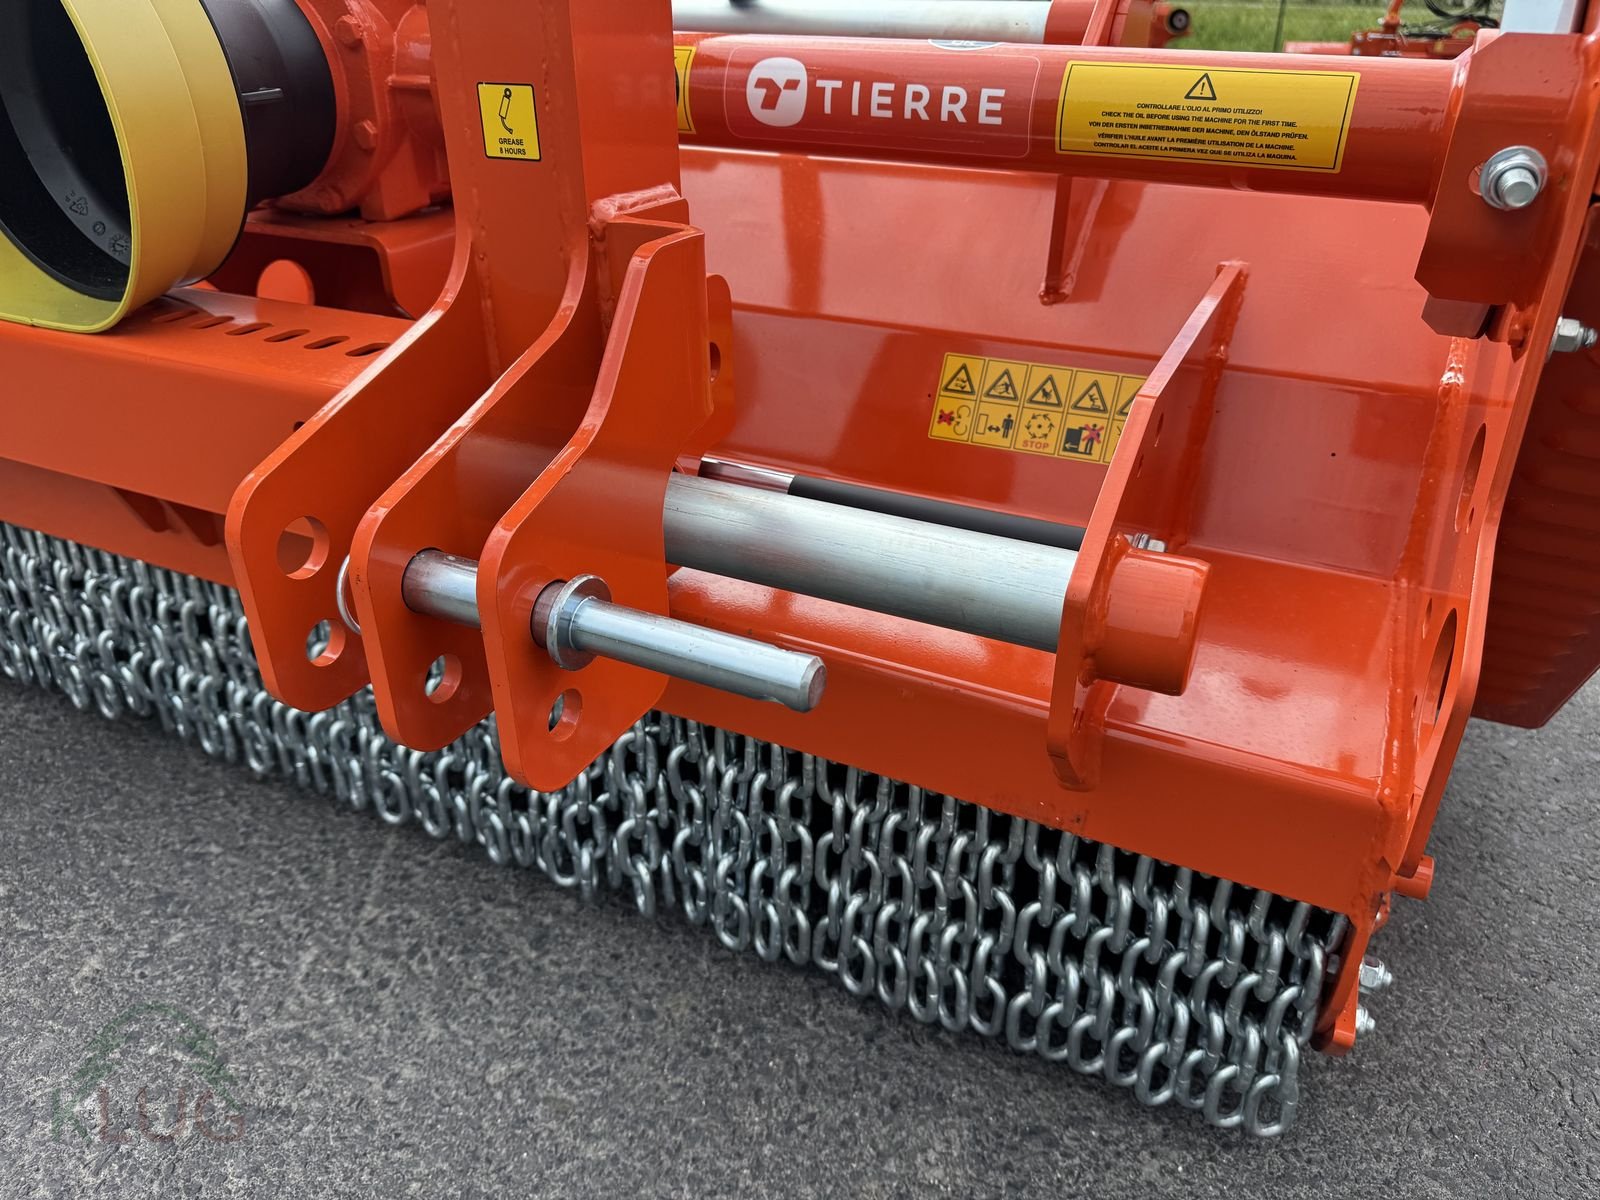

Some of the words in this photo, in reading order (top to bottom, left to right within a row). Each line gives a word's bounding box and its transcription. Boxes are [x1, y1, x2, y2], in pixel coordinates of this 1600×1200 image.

[816, 79, 1006, 125] TIERRE
[1139, 124, 1190, 132] INBETRIEBNAHME
[1251, 130, 1280, 138] ÖLSTAND
[1281, 132, 1308, 140] PRÜFEN.
[1022, 440, 1049, 450] STOP
